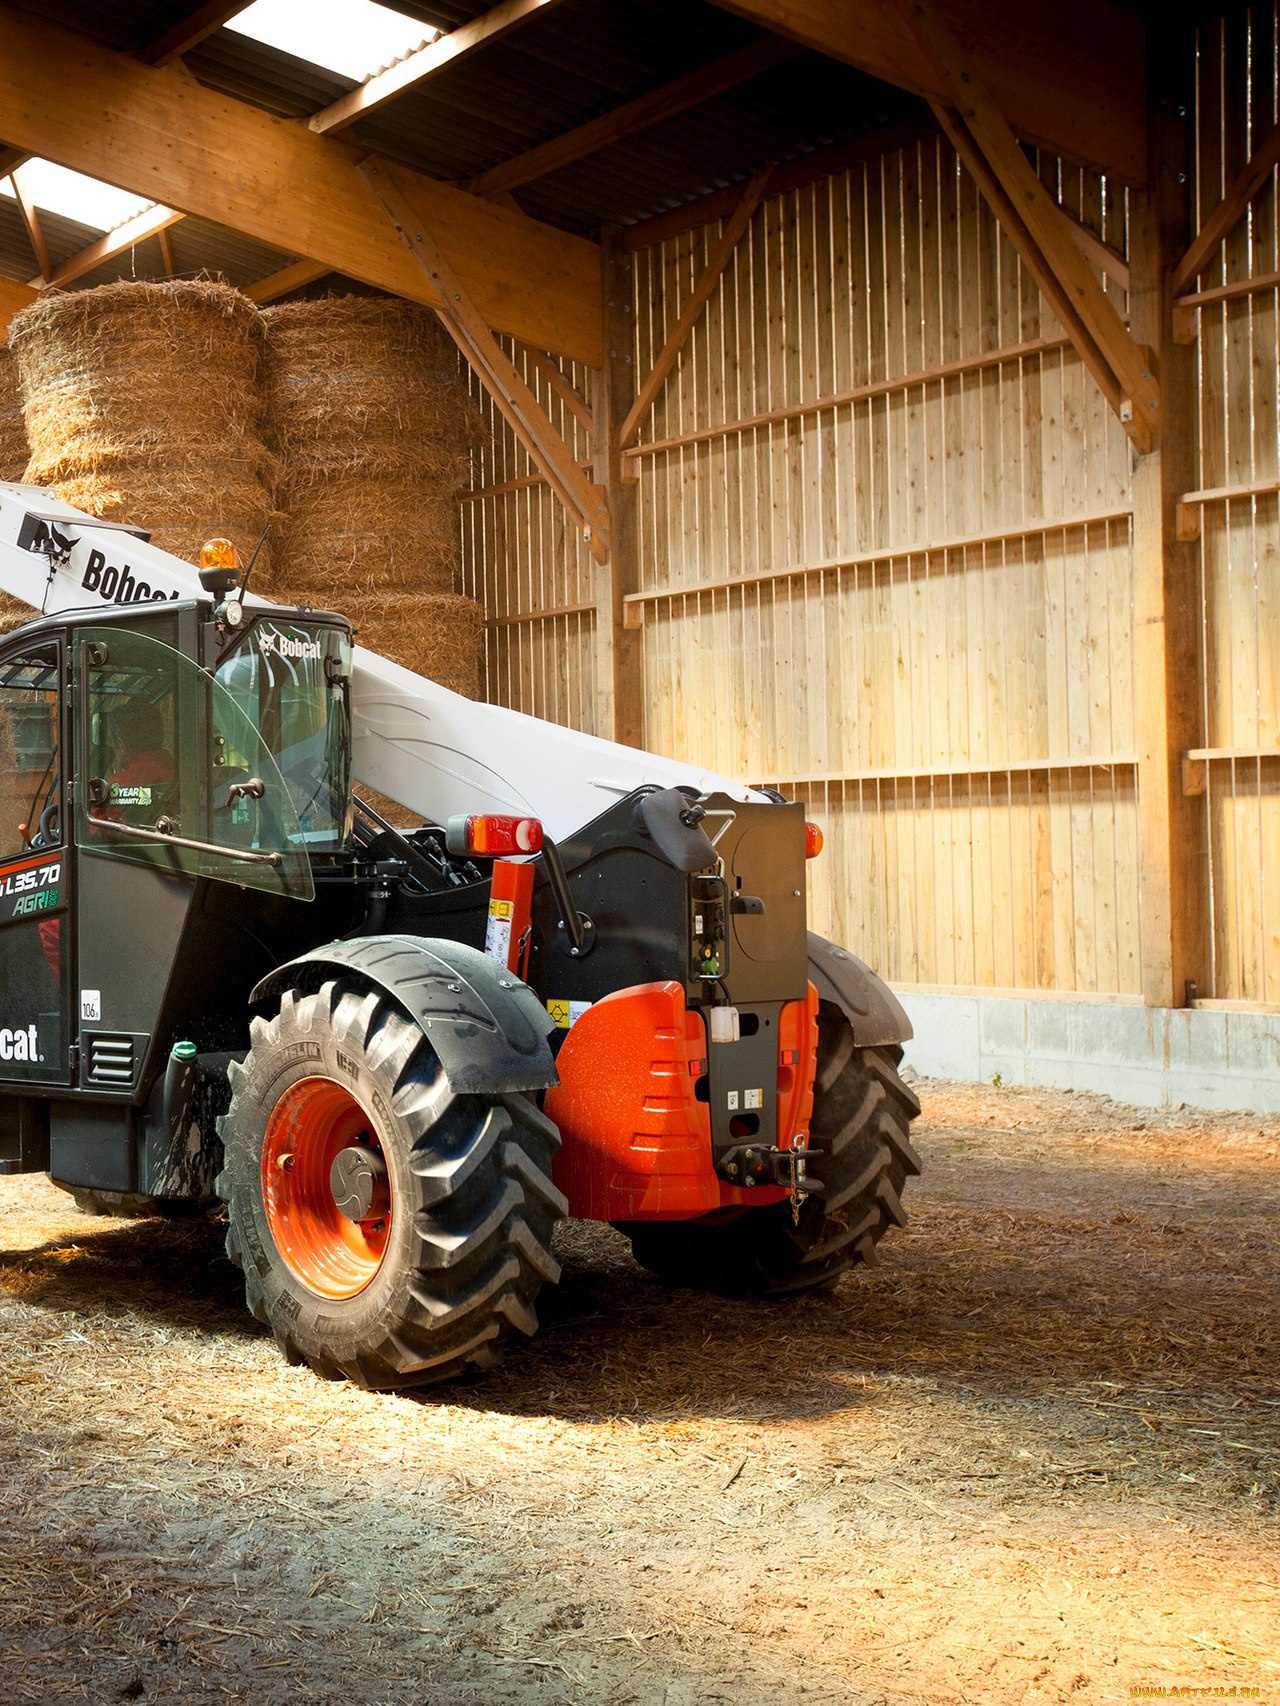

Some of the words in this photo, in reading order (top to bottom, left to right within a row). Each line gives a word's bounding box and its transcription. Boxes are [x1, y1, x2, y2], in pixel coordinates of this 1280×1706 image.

[82, 548, 179, 604] Bobc
[280, 637, 321, 659] Bobcat
[119, 787, 139, 797] YEAR
[12, 890, 50, 917] AGRI
[83, 1003, 95, 1018] 106
